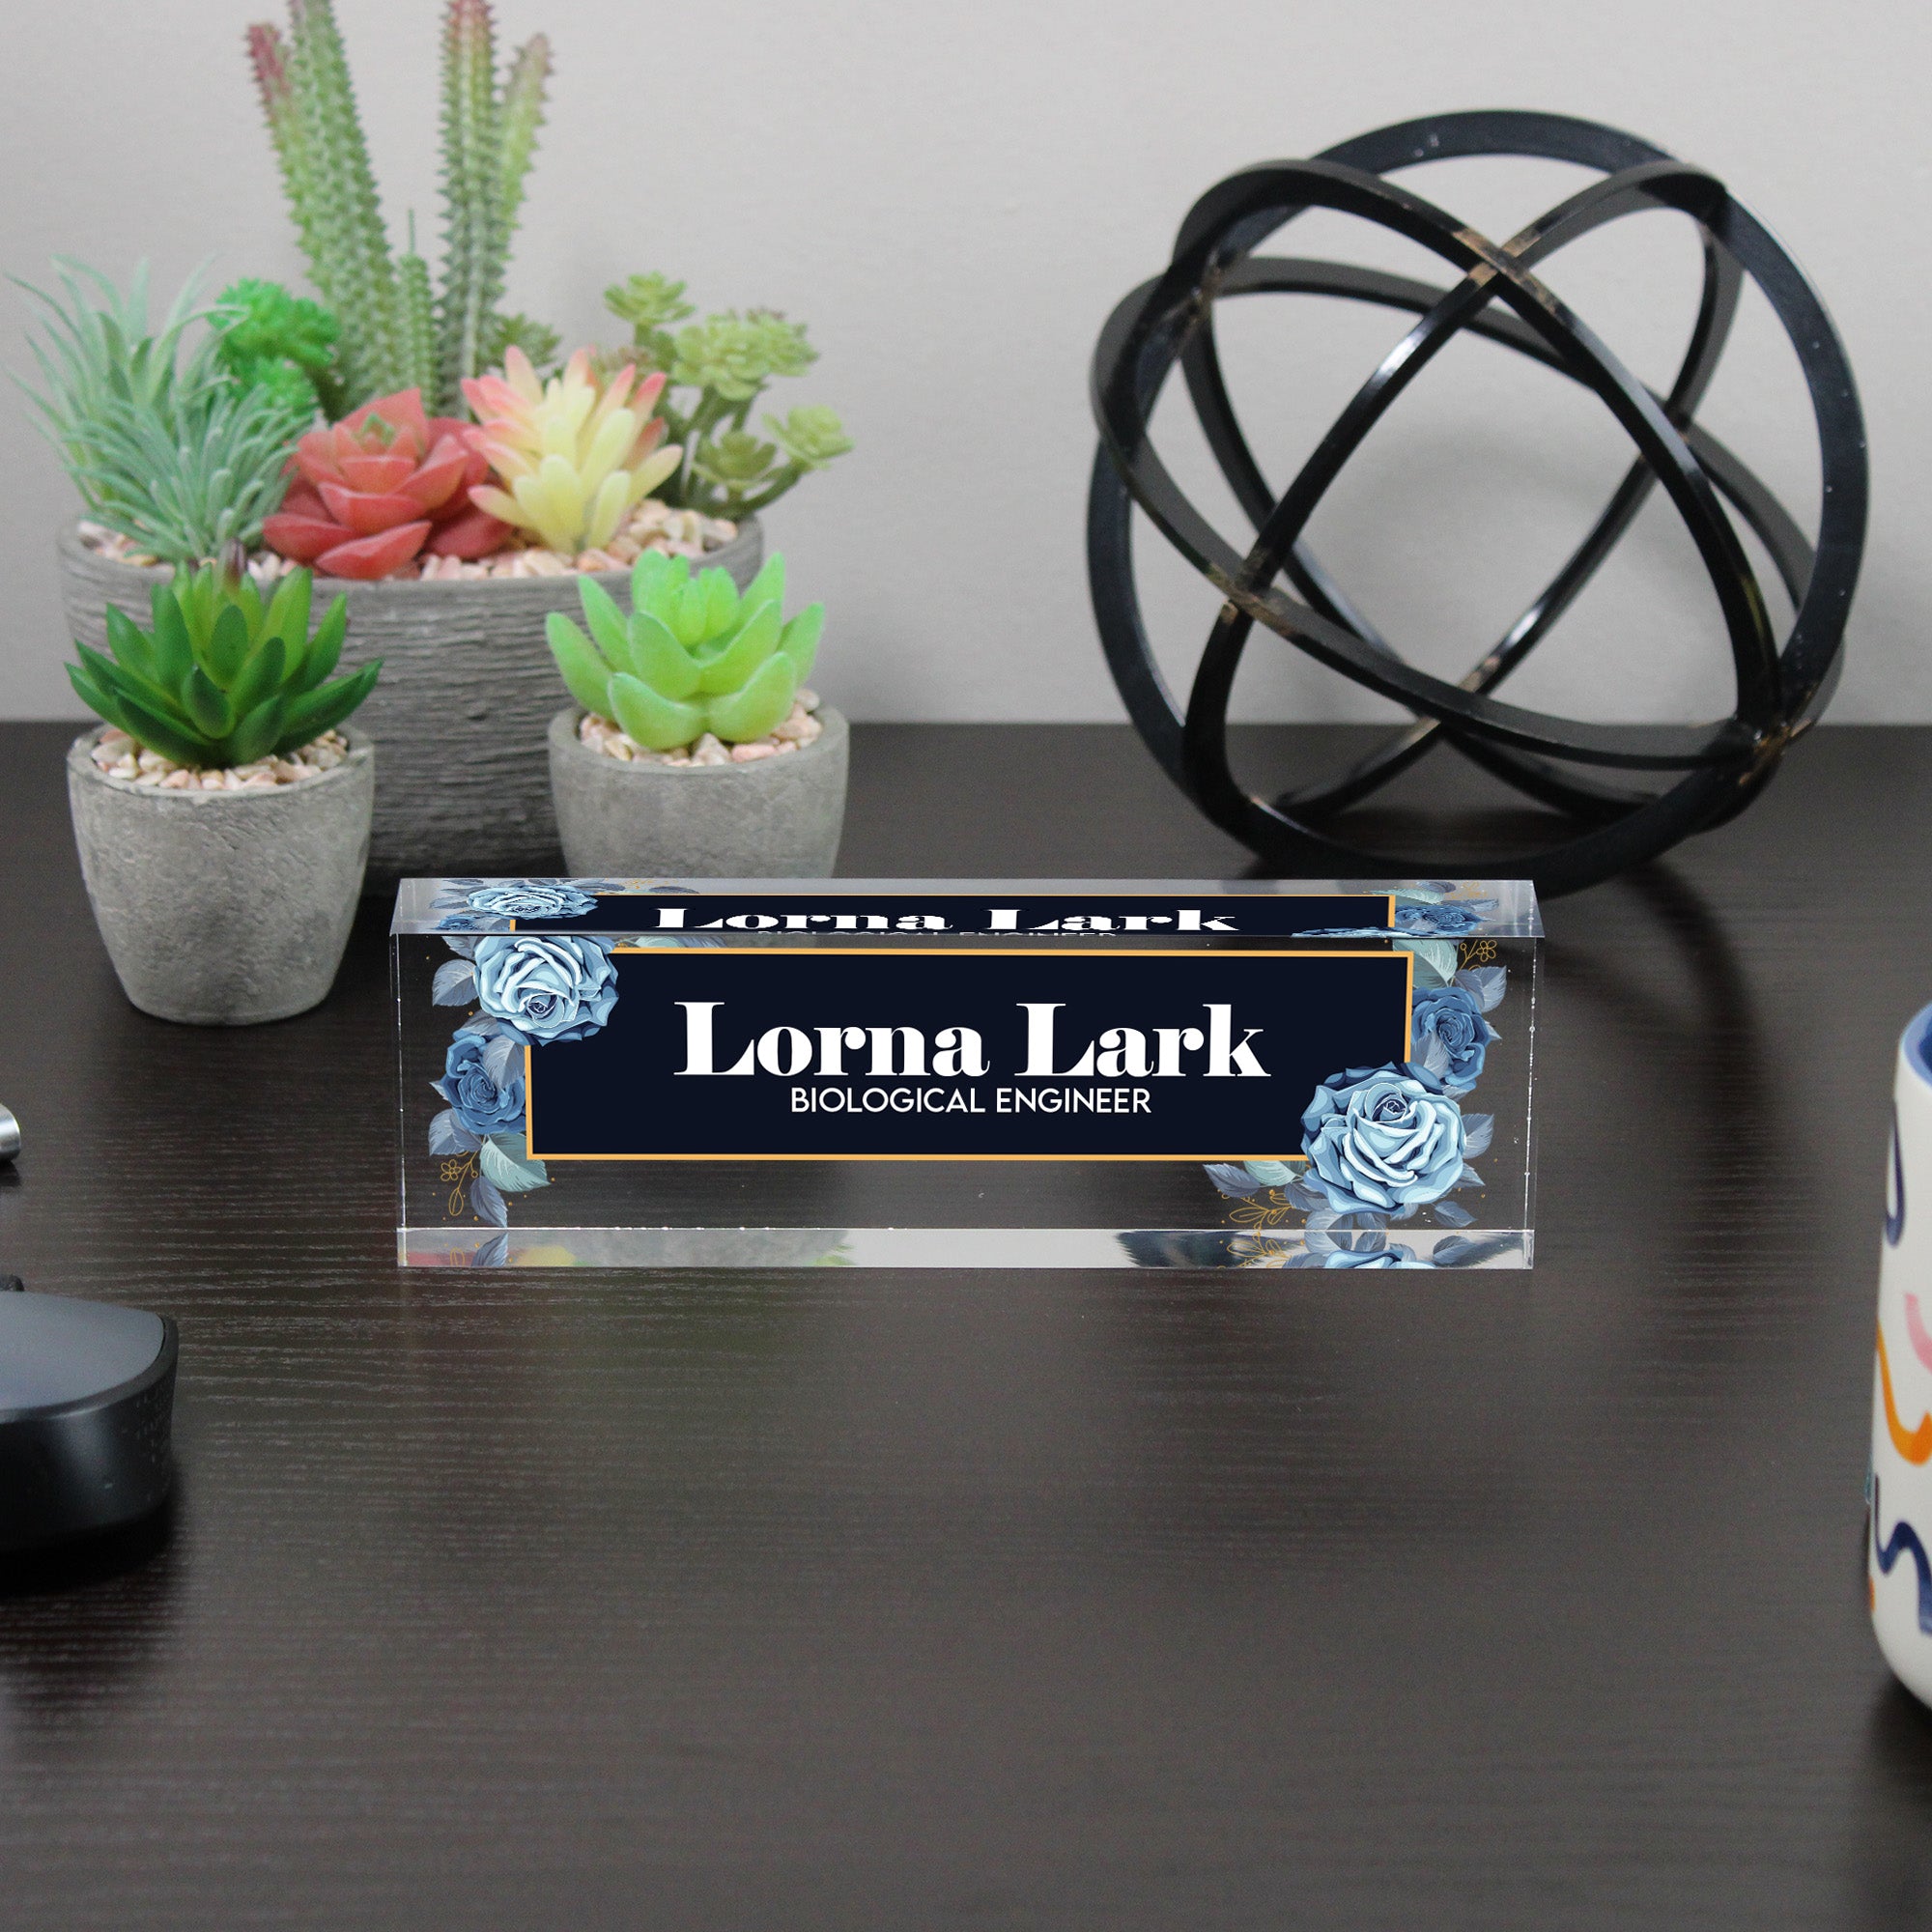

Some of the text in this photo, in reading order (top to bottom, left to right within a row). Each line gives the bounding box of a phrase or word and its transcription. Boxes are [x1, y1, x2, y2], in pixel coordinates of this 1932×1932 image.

[655, 908, 1239, 931] Lorna Lark
[673, 1001, 1272, 1078] Lorna Lark
[790, 1087, 1152, 1114] BIOLOGICAL ENGINEER
